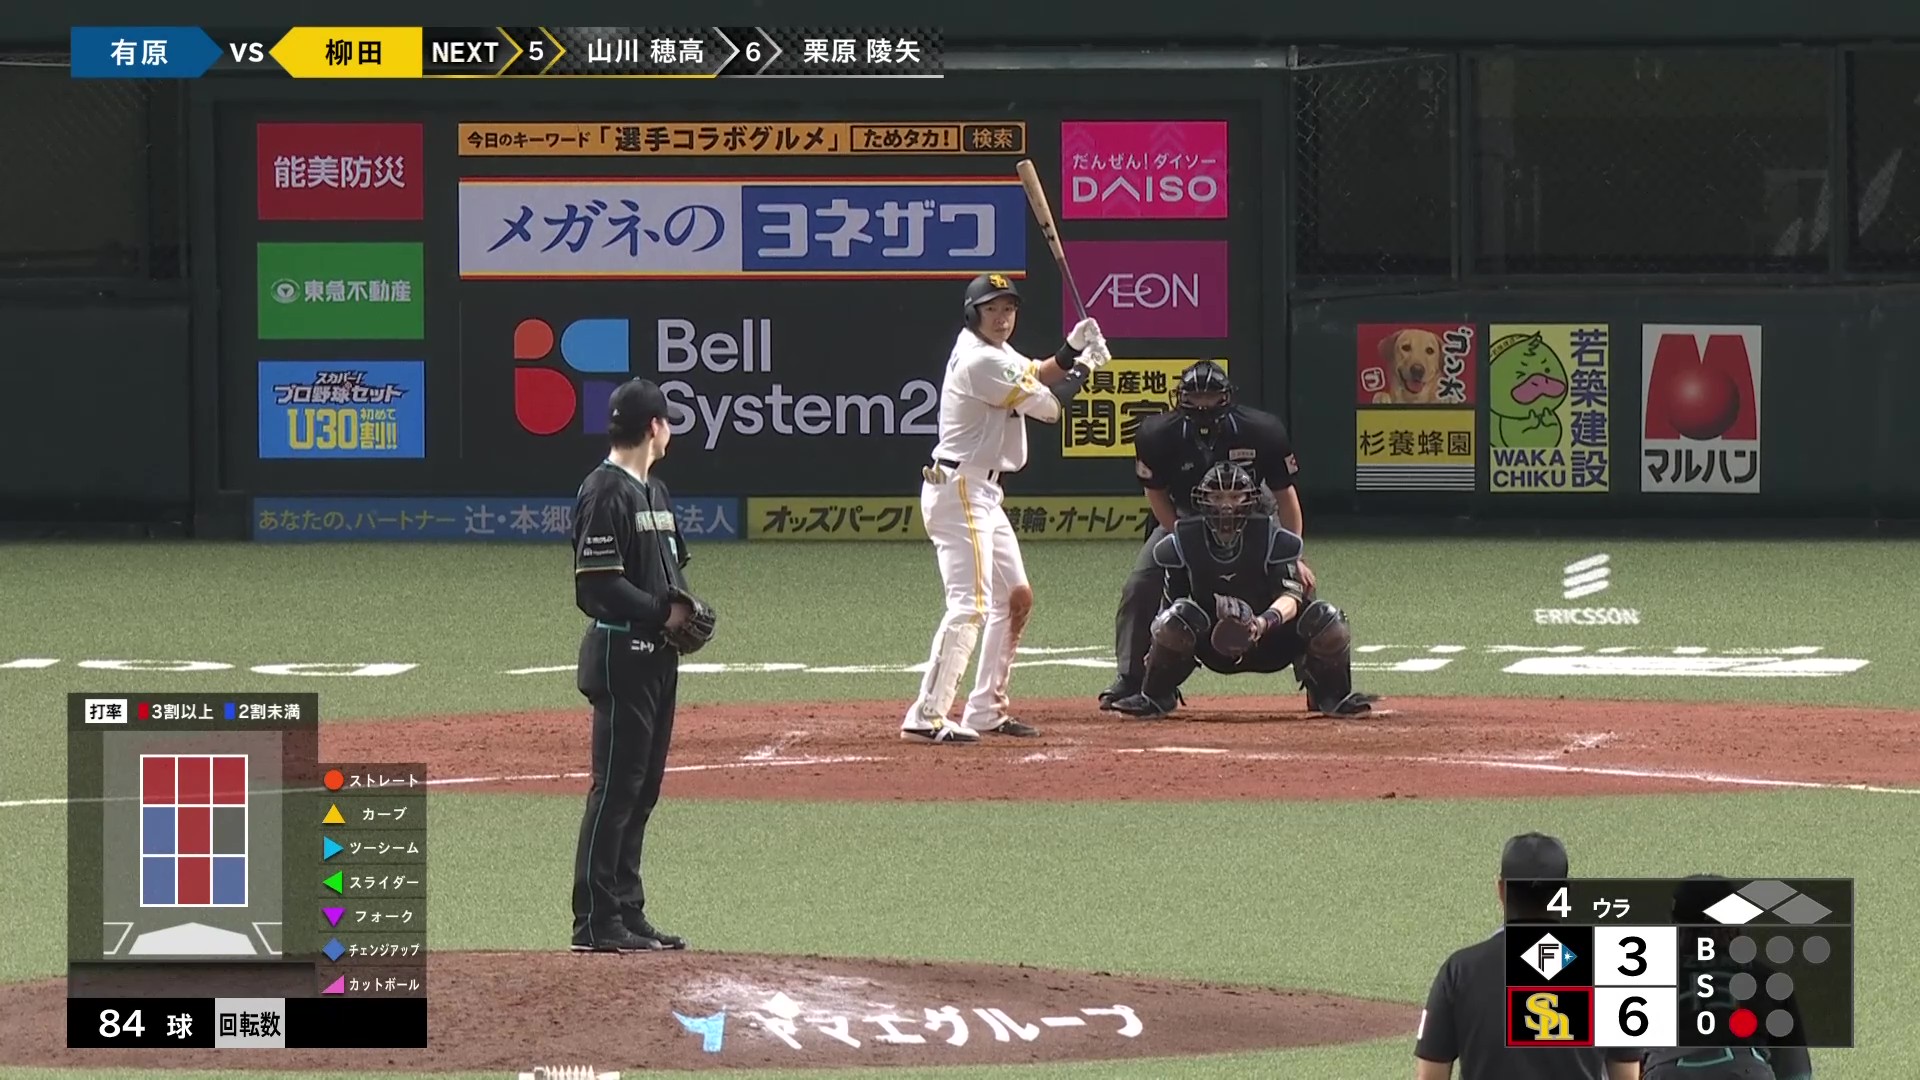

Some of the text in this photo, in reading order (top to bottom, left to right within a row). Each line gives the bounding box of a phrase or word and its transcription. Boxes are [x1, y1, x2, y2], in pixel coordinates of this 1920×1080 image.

[864, 129, 949, 148] ためタカ!
[972, 129, 1012, 149] 検索
[274, 156, 405, 189] 能美防災
[1072, 176, 1217, 202] DAISO
[487, 199, 725, 257] メガネの
[757, 199, 996, 258] ヨネザワ
[304, 279, 411, 302] 東急不動産
[658, 319, 771, 372] Bell
[274, 385, 403, 404] プロ野球セット
[657, 379, 941, 449] System2
[1570, 329, 1608, 488] 若築建設
[1359, 430, 1472, 456] 杉養蜂園
[1493, 449, 1566, 467] WAKA
[1645, 449, 1757, 484] マルハン
[1493, 470, 1566, 488] CHIKU
[1534, 607, 1641, 625] ERICSSON
